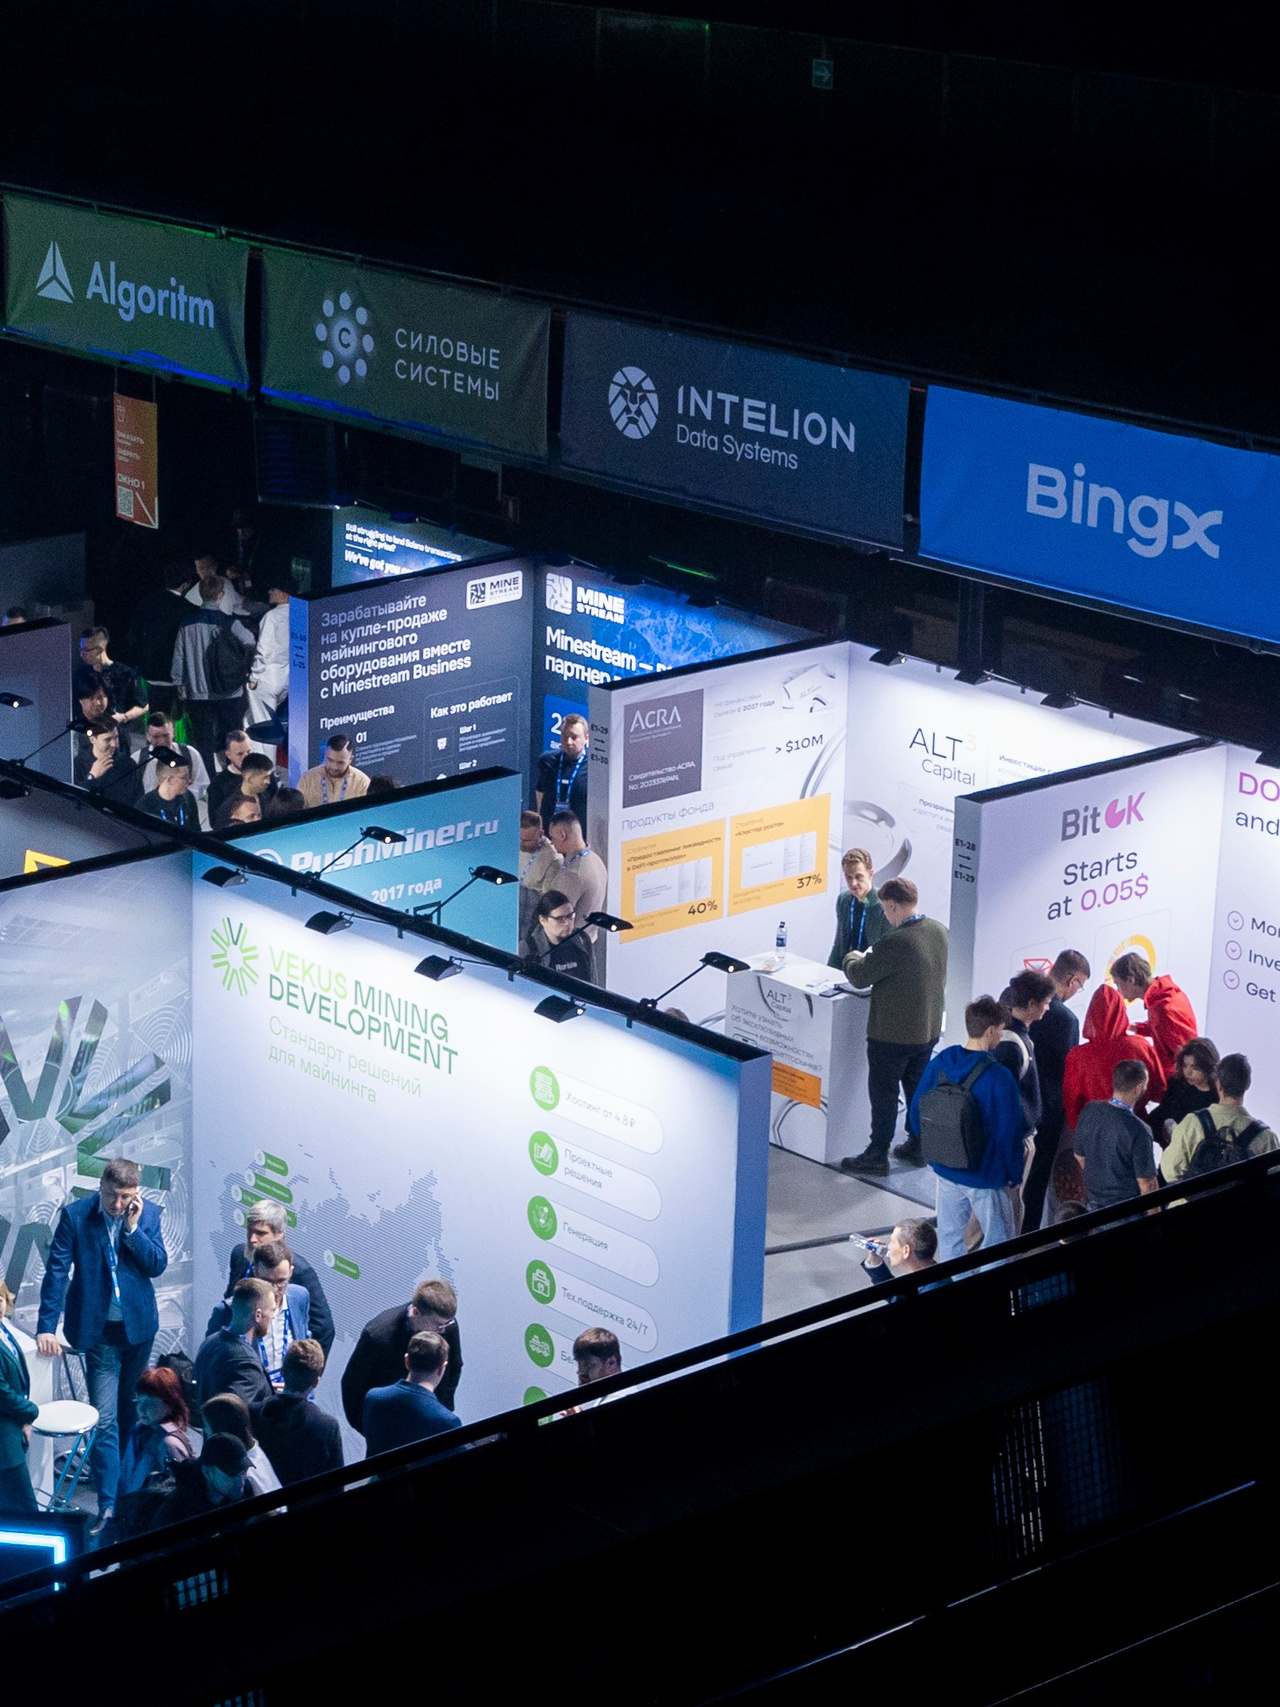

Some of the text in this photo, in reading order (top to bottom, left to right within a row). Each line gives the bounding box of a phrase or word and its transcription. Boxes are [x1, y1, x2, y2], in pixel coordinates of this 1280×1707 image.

[86, 260, 215, 329] Algoritm
[394, 328, 501, 370] СИЛОВЫЕ
[394, 358, 501, 401] СИСТЕМЫ
[676, 384, 857, 454] INTELION
[676, 424, 799, 471] Data Systems
[1025, 462, 1224, 559] Bingx
[344, 549, 385, 571] We've got
[489, 576, 520, 591] MINE
[489, 585, 520, 597] STREAM
[321, 595, 427, 627] Зарабатывайте
[576, 586, 625, 614] MINE
[576, 604, 625, 624] STREAM
[321, 607, 448, 646] на купле-продаже
[321, 632, 419, 664] майнингового
[321, 649, 420, 682] оборудования
[422, 639, 472, 660] вместе
[546, 625, 637, 672] Minestream
[332, 654, 472, 698] Minestream Business
[320, 703, 395, 730] Преимущества
[430, 692, 513, 720] Как это работает
[629, 705, 682, 733] ACRA
[356, 731, 368, 744] 01
[785, 734, 824, 754] $10M
[909, 727, 963, 761] ALT
[921, 758, 976, 786] Capital
[621, 801, 715, 831] Продукты фонда
[1235, 811, 1280, 837] and
[954, 837, 977, 852] E1-28
[796, 873, 823, 890] 37%
[953, 869, 976, 884] E1-29
[1063, 850, 1138, 887] Starts
[370, 876, 443, 904] 2017 года
[1046, 873, 1150, 921] at 0.05$
[687, 899, 718, 916] 40%
[268, 944, 449, 1043] VEKUS MINING
[766, 989, 787, 1004] ALT
[1246, 981, 1277, 1003] Get
[269, 973, 459, 1075] DEVELOPMENT
[731, 1004, 783, 1029] Хотите узнать
[269, 1015, 422, 1098] Стандарт решений
[269, 1045, 376, 1103] для майнинга
[564, 1148, 613, 1179] Проектные
[564, 1166, 603, 1190] решения
[562, 1221, 609, 1251] Генерация
[561, 1286, 648, 1335] Тех.поддержка 24/7
